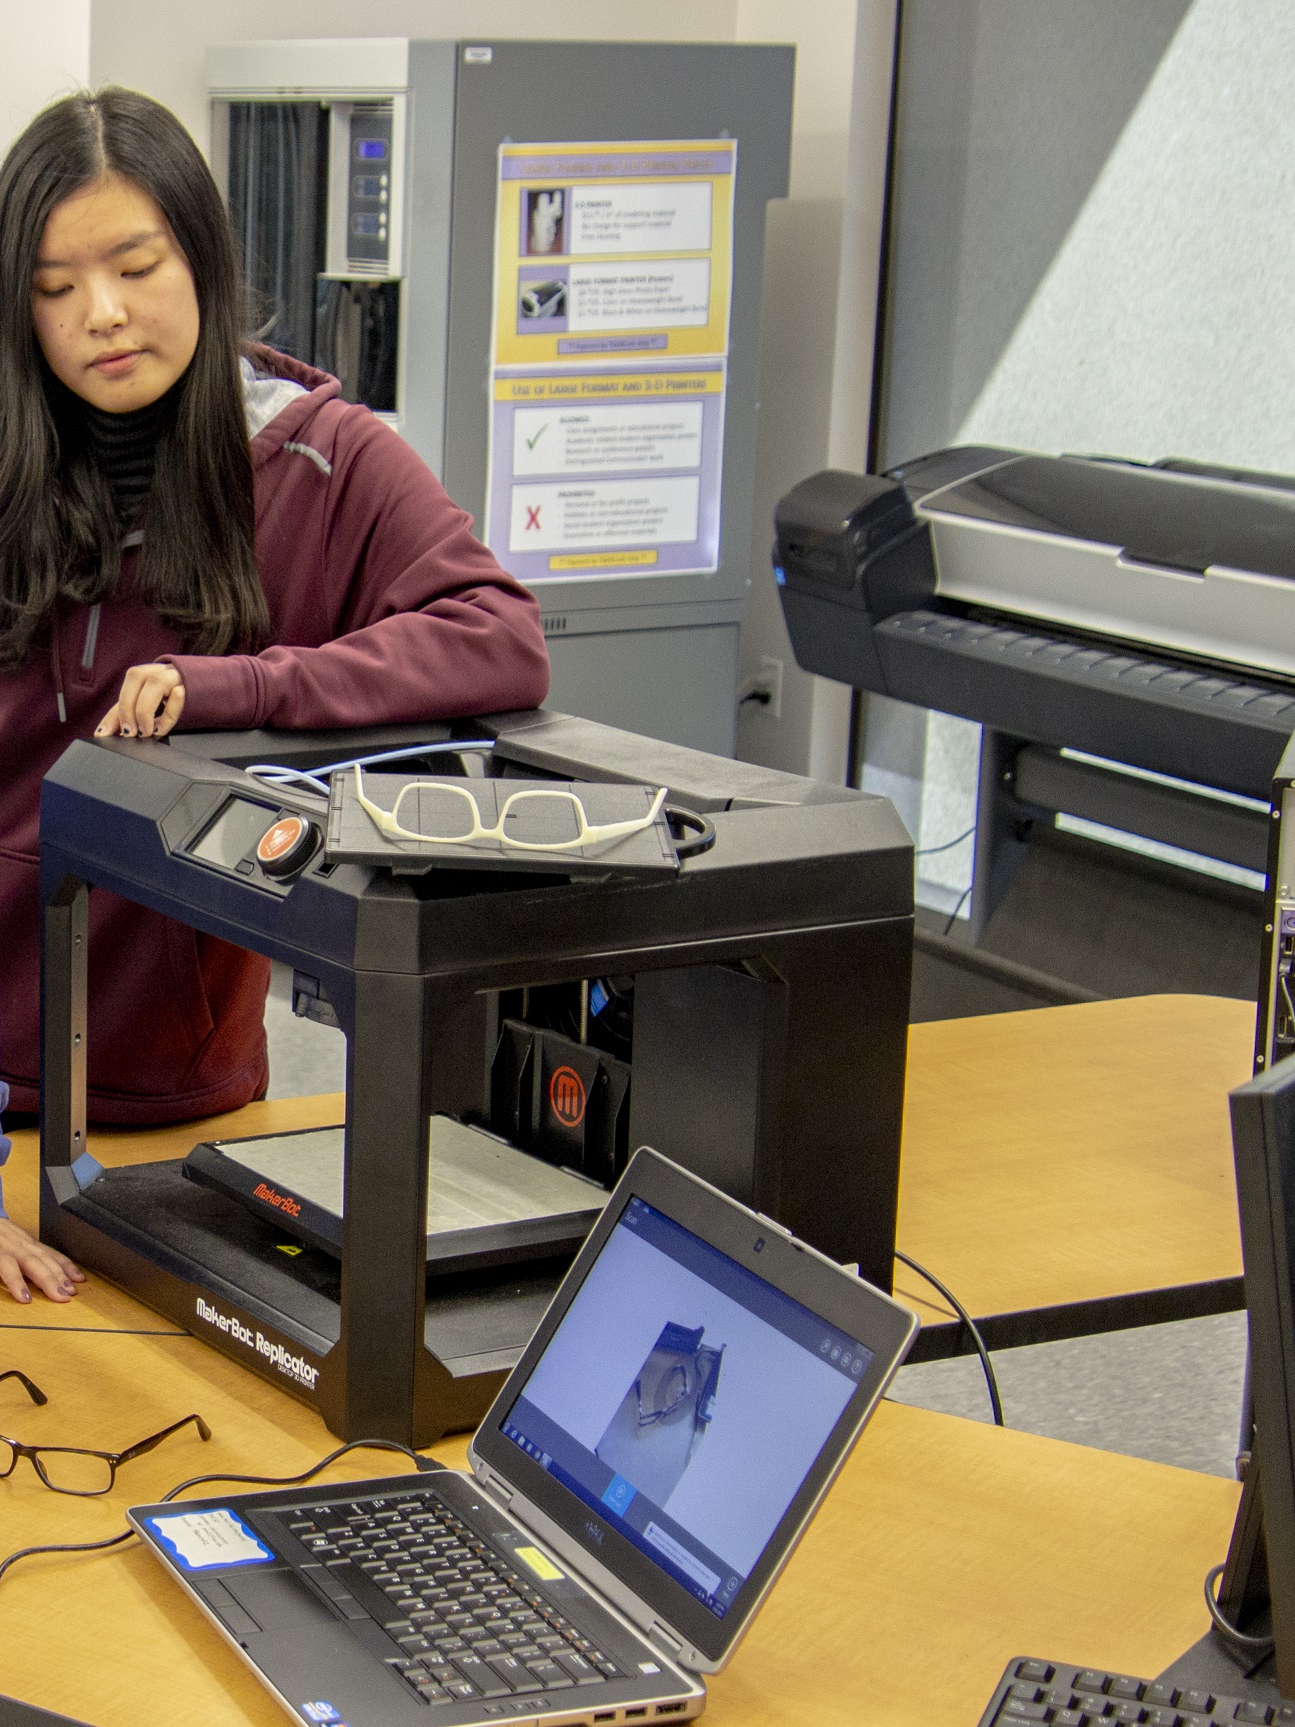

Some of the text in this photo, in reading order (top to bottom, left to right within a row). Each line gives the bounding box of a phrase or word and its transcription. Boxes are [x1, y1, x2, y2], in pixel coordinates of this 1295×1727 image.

[253, 1183, 302, 1217] MakerBot
[196, 1297, 319, 1383] MakerBot Replicator
